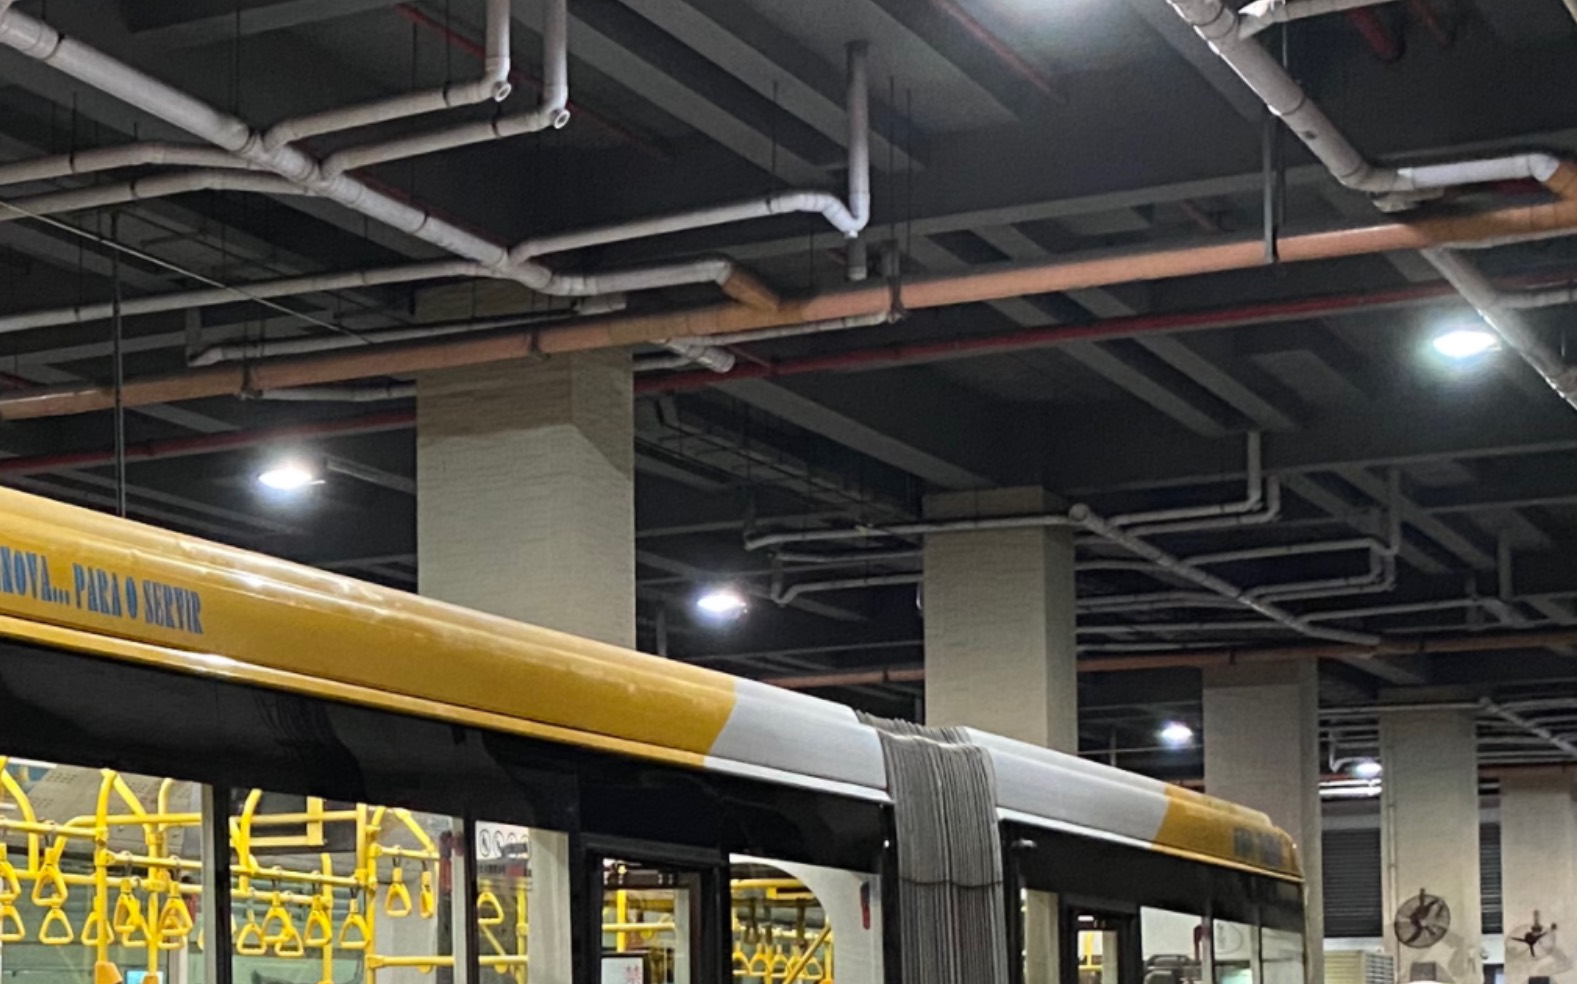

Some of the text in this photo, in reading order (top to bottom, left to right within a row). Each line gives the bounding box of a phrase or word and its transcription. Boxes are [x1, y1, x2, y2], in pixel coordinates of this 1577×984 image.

[72, 562, 122, 617] PARA
[126, 575, 138, 620] O
[142, 579, 203, 635] SERVIR
